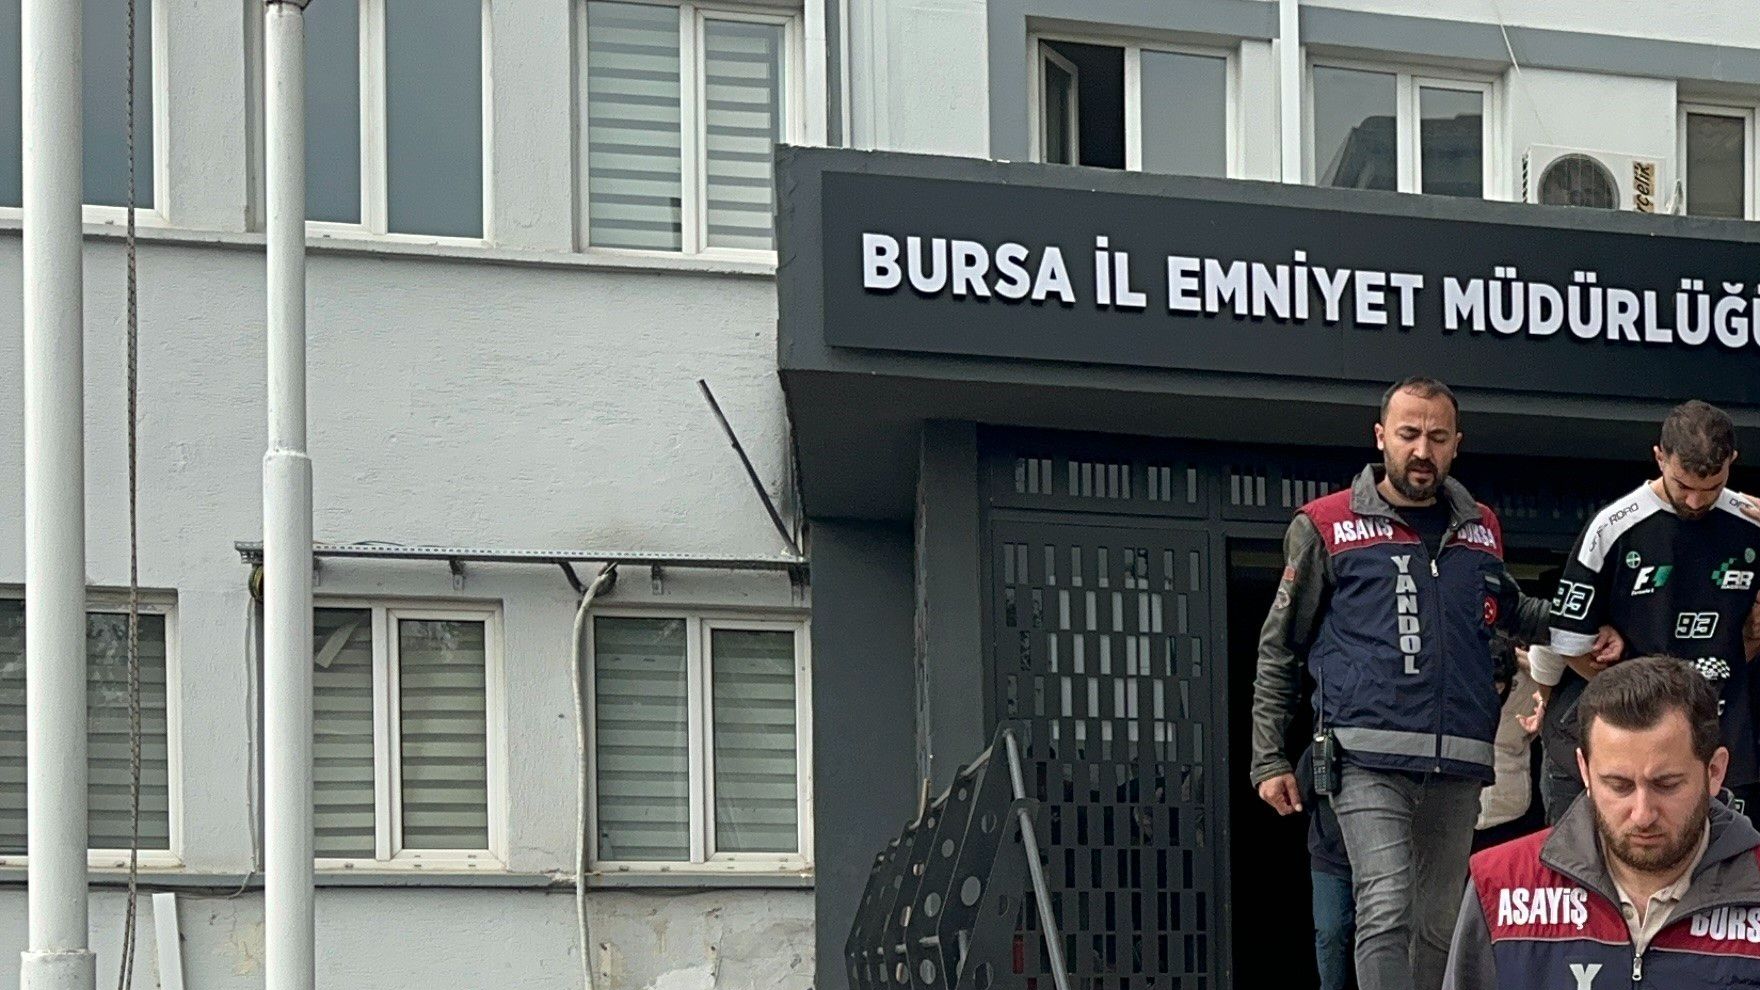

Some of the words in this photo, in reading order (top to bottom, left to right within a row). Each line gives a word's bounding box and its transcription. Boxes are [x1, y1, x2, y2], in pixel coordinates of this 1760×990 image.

[1633, 162, 1654, 213] rçelik
[862, 232, 1077, 303] BURSA
[1095, 235, 1147, 308] İL
[1167, 250, 1424, 327] EMNİYET
[1390, 554, 1421, 675] YANDOL
[1675, 611, 1719, 639] 93
[1497, 887, 1589, 930] ASAYİŞ
